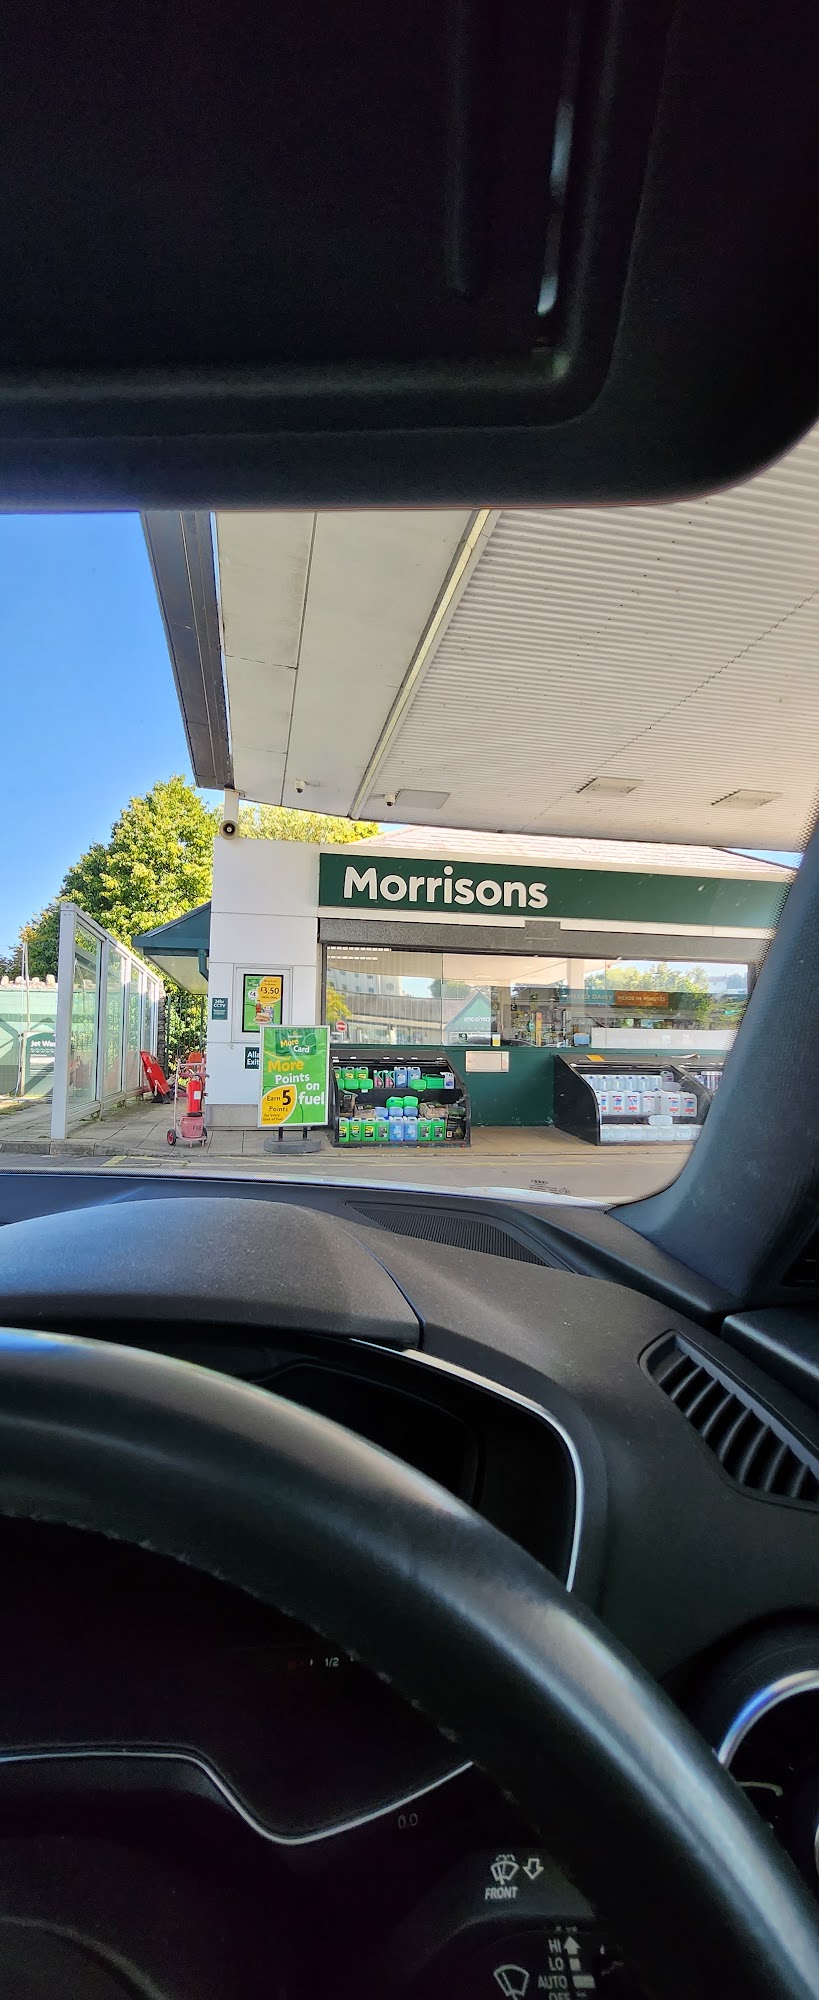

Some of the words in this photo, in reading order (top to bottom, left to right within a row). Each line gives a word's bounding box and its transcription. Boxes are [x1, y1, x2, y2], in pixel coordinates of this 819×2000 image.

[343, 865, 549, 909] Morrisons
[260, 986, 280, 995] £3.50
[280, 1039, 299, 1048] More
[293, 1045, 310, 1053] Card
[267, 1060, 304, 1073] More
[275, 1073, 310, 1085] Points
[305, 1082, 320, 1091] on
[282, 1089, 292, 1106] 5
[298, 1091, 325, 1105] fuel
[324, 1656, 340, 1668] 1/2
[485, 1886, 519, 1900] FRONT
[548, 1938, 562, 1953] HI
[548, 1956, 564, 1971] LO
[537, 1975, 568, 1989] AUTO
